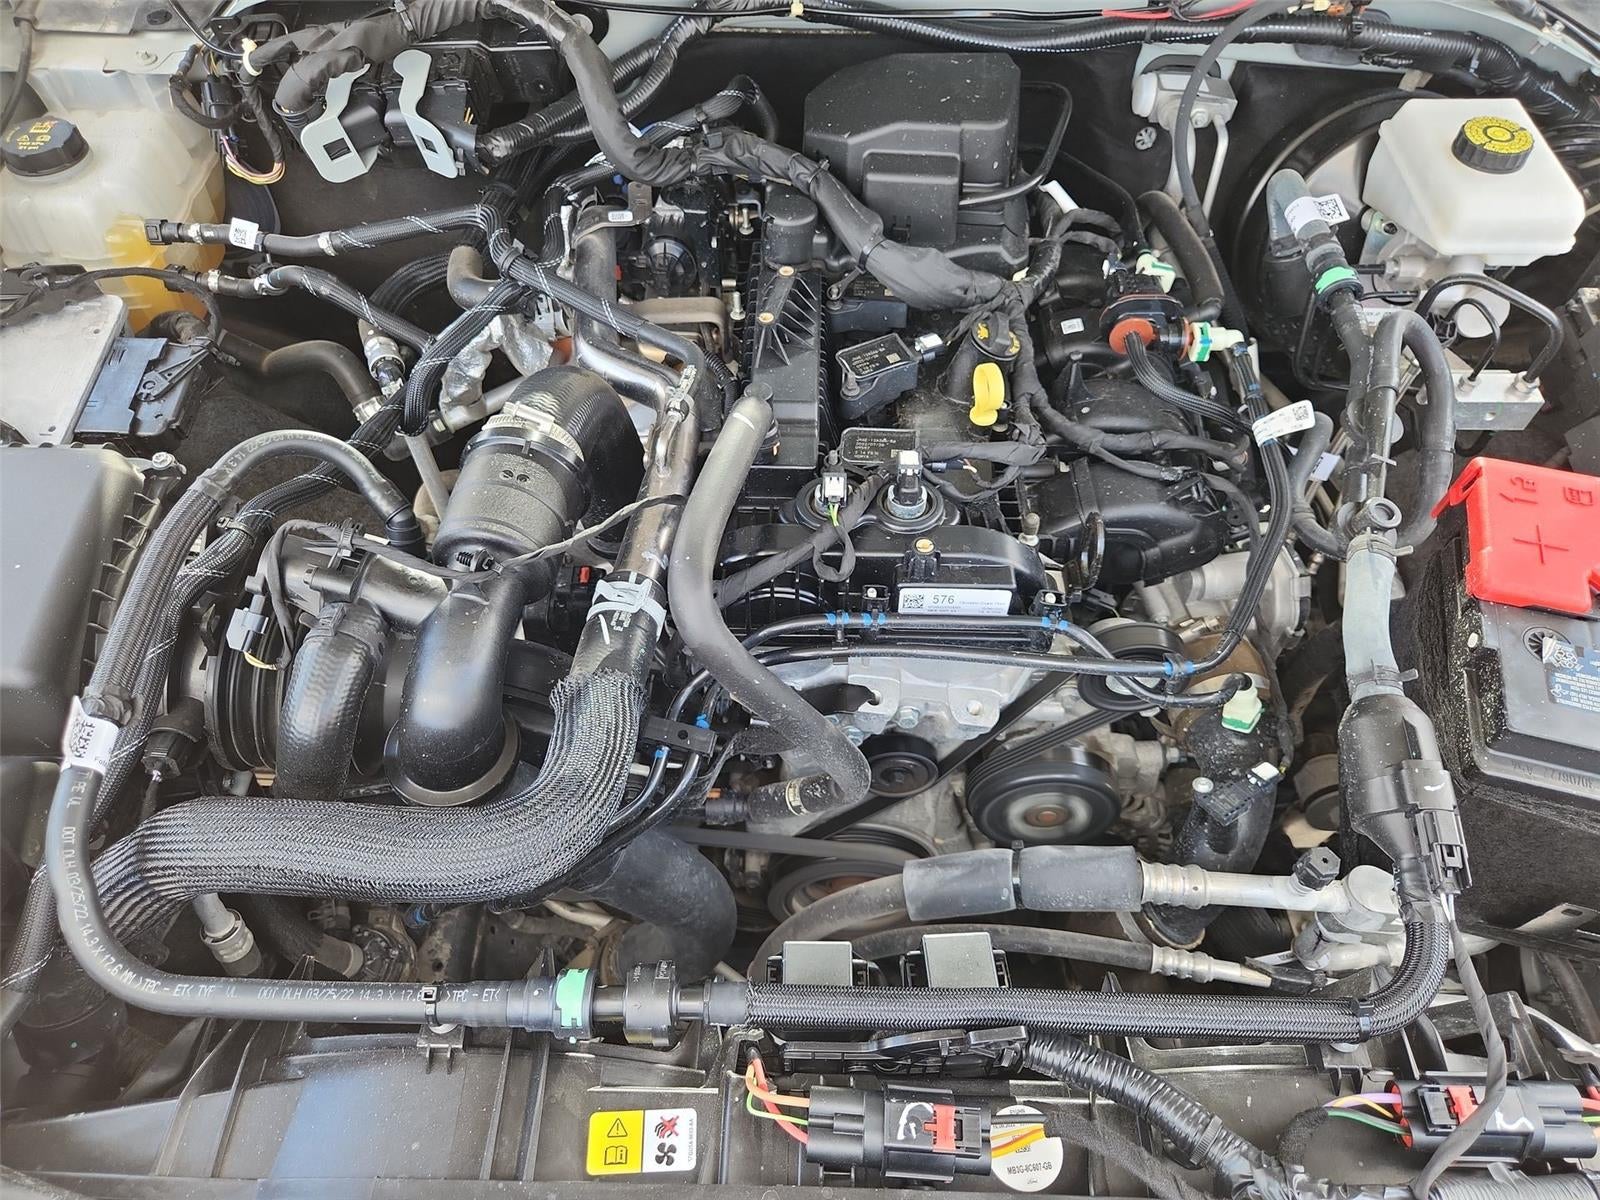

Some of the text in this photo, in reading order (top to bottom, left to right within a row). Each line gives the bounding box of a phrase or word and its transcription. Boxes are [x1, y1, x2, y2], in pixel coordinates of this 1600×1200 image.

[932, 594, 955, 605] 576
[304, 988, 354, 1001] 03/25/22
[359, 988, 383, 1001] 14.3
